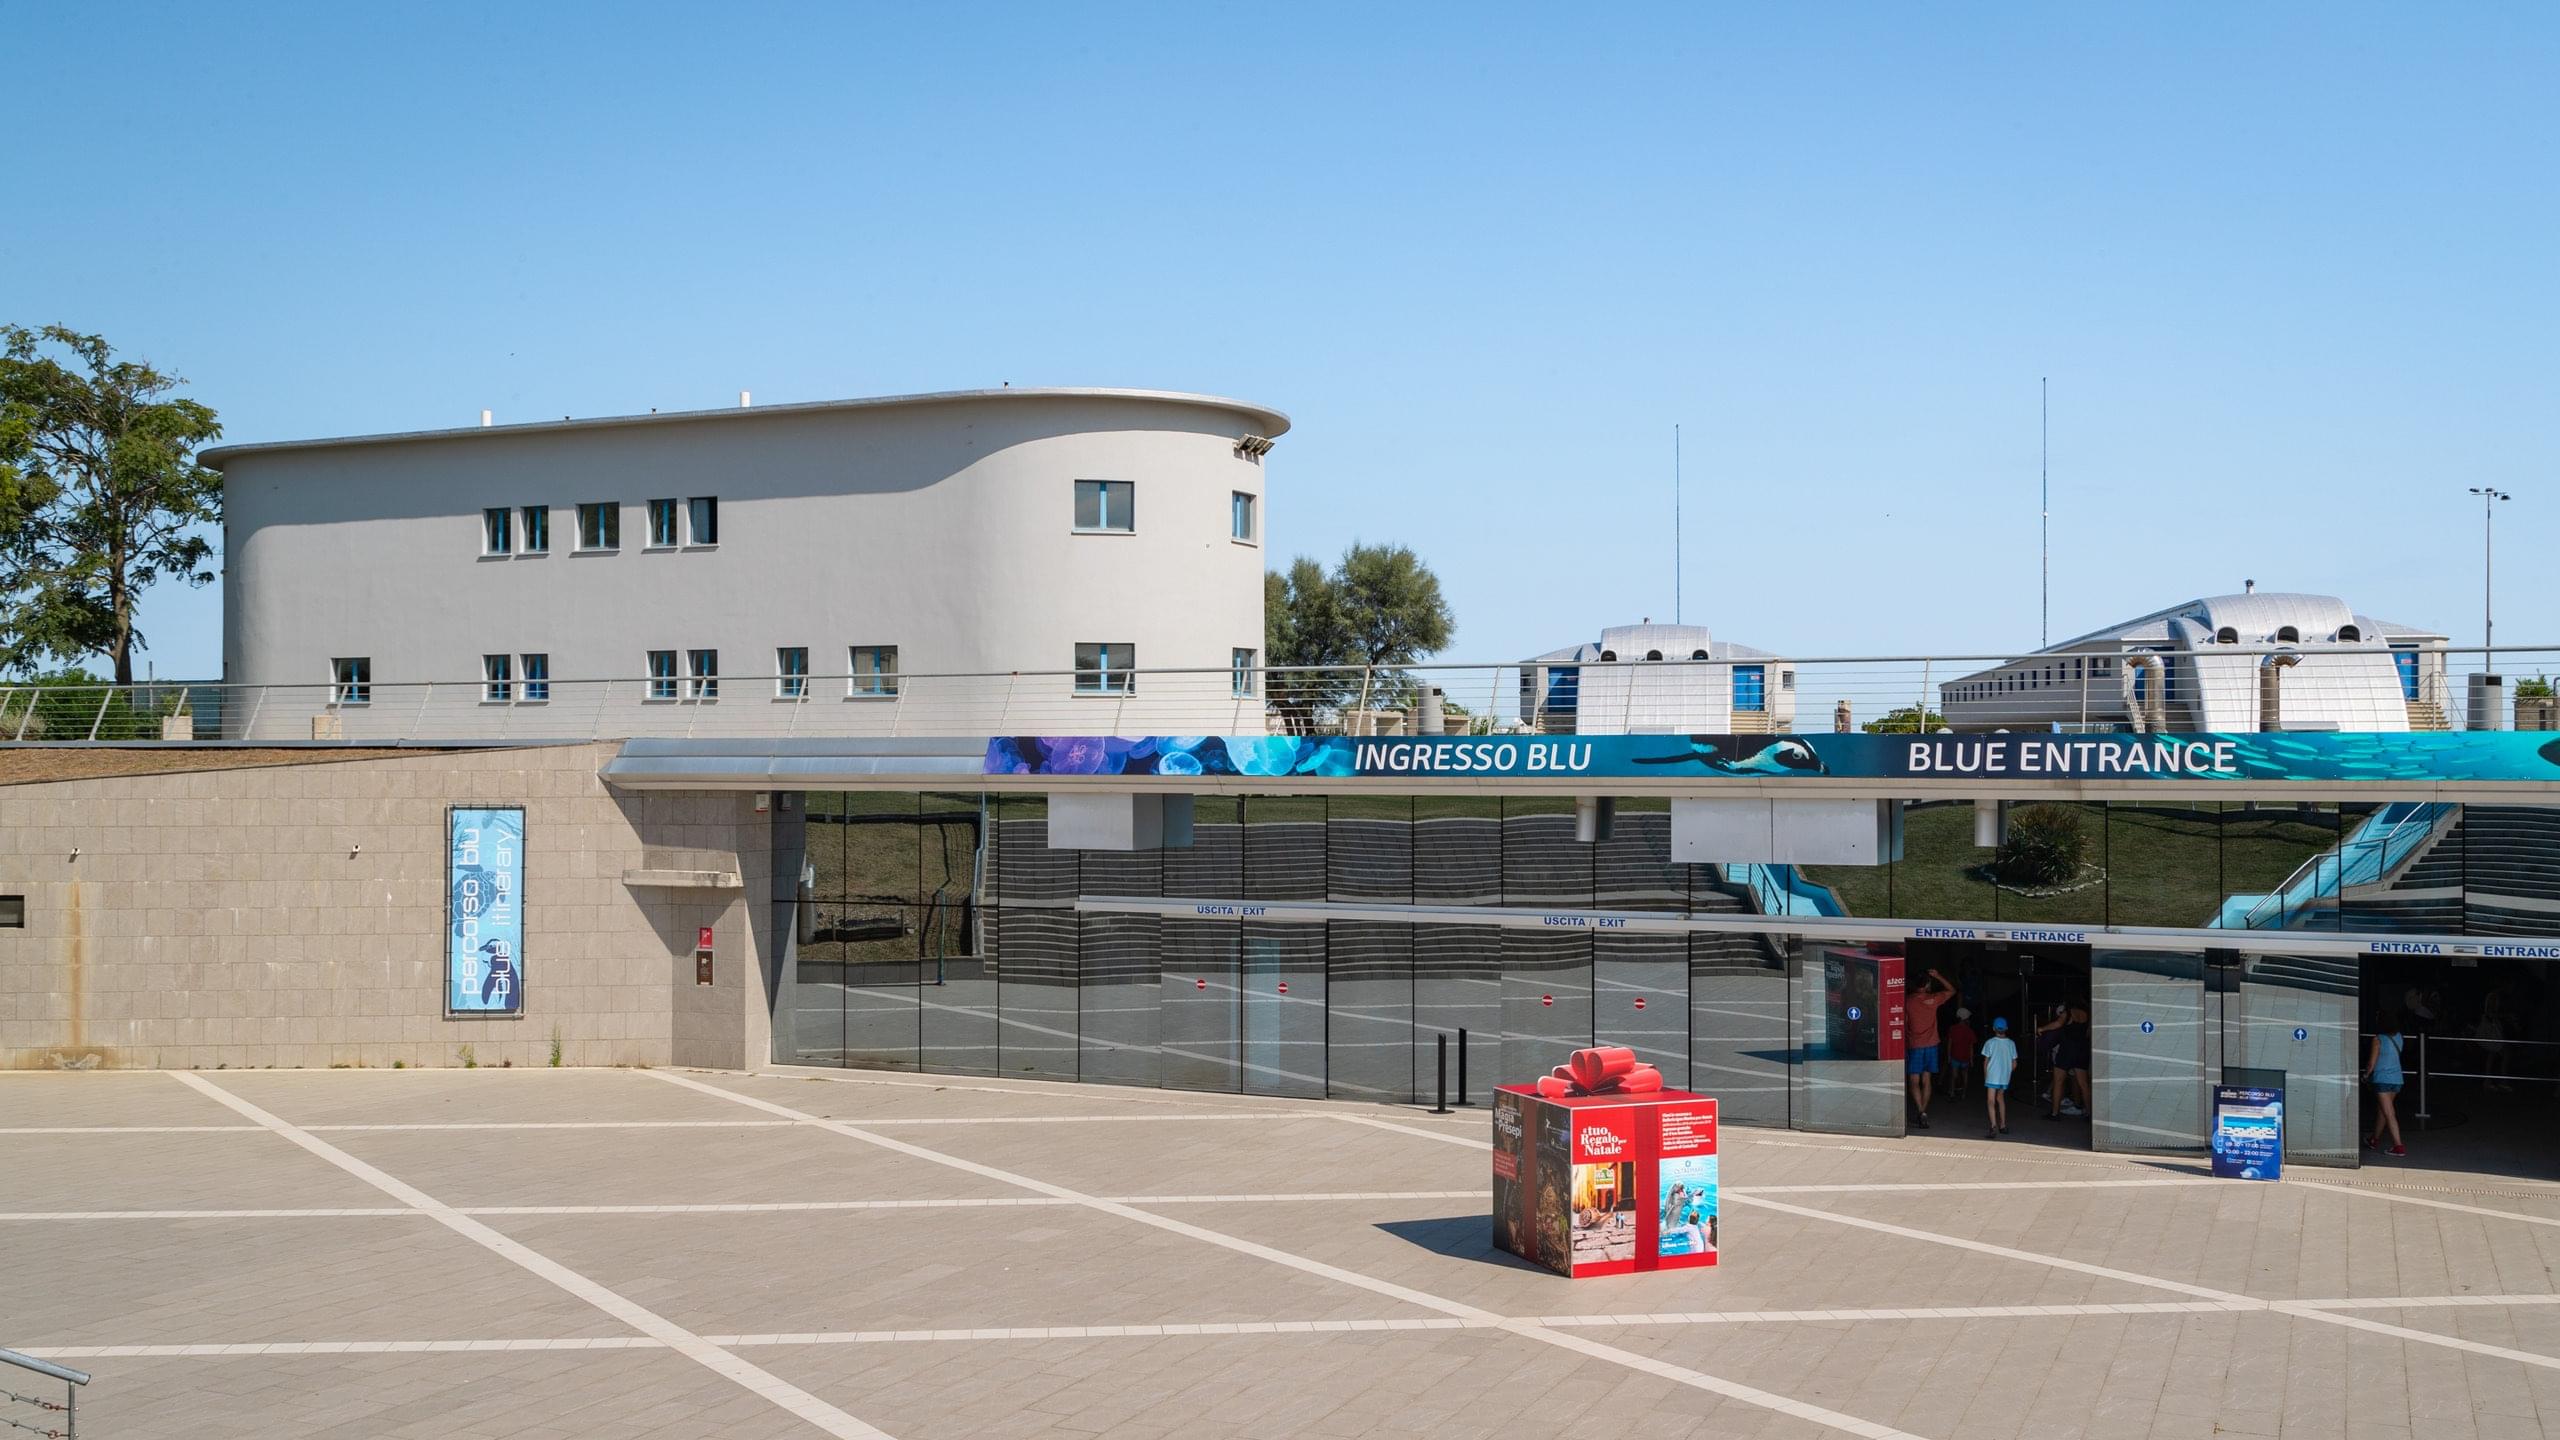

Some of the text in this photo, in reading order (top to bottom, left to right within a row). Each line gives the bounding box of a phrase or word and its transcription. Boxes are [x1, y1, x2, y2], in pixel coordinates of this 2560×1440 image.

[1355, 743, 1593, 772] INGRESSO BLU
[1908, 742, 2238, 774] BLUE ENTRANCE
[459, 828, 481, 996] percorso blu
[490, 828, 516, 996] blue itinerary
[1197, 904, 1233, 915] USCITA
[1242, 906, 1266, 917] EXIT
[1543, 916, 1587, 927] USCITA
[1599, 917, 1626, 928] EXIT
[1915, 927, 2085, 943] ENTRATA ENTRANCE
[2371, 942, 2441, 955] ENTRATA
[1495, 1108, 1514, 1124] Magia
[1499, 1120, 1522, 1138] Presepi
[1588, 1126, 1608, 1136] tuo
[1580, 1132, 1619, 1146] Regalo
[1584, 1143, 1622, 1156] Natale
